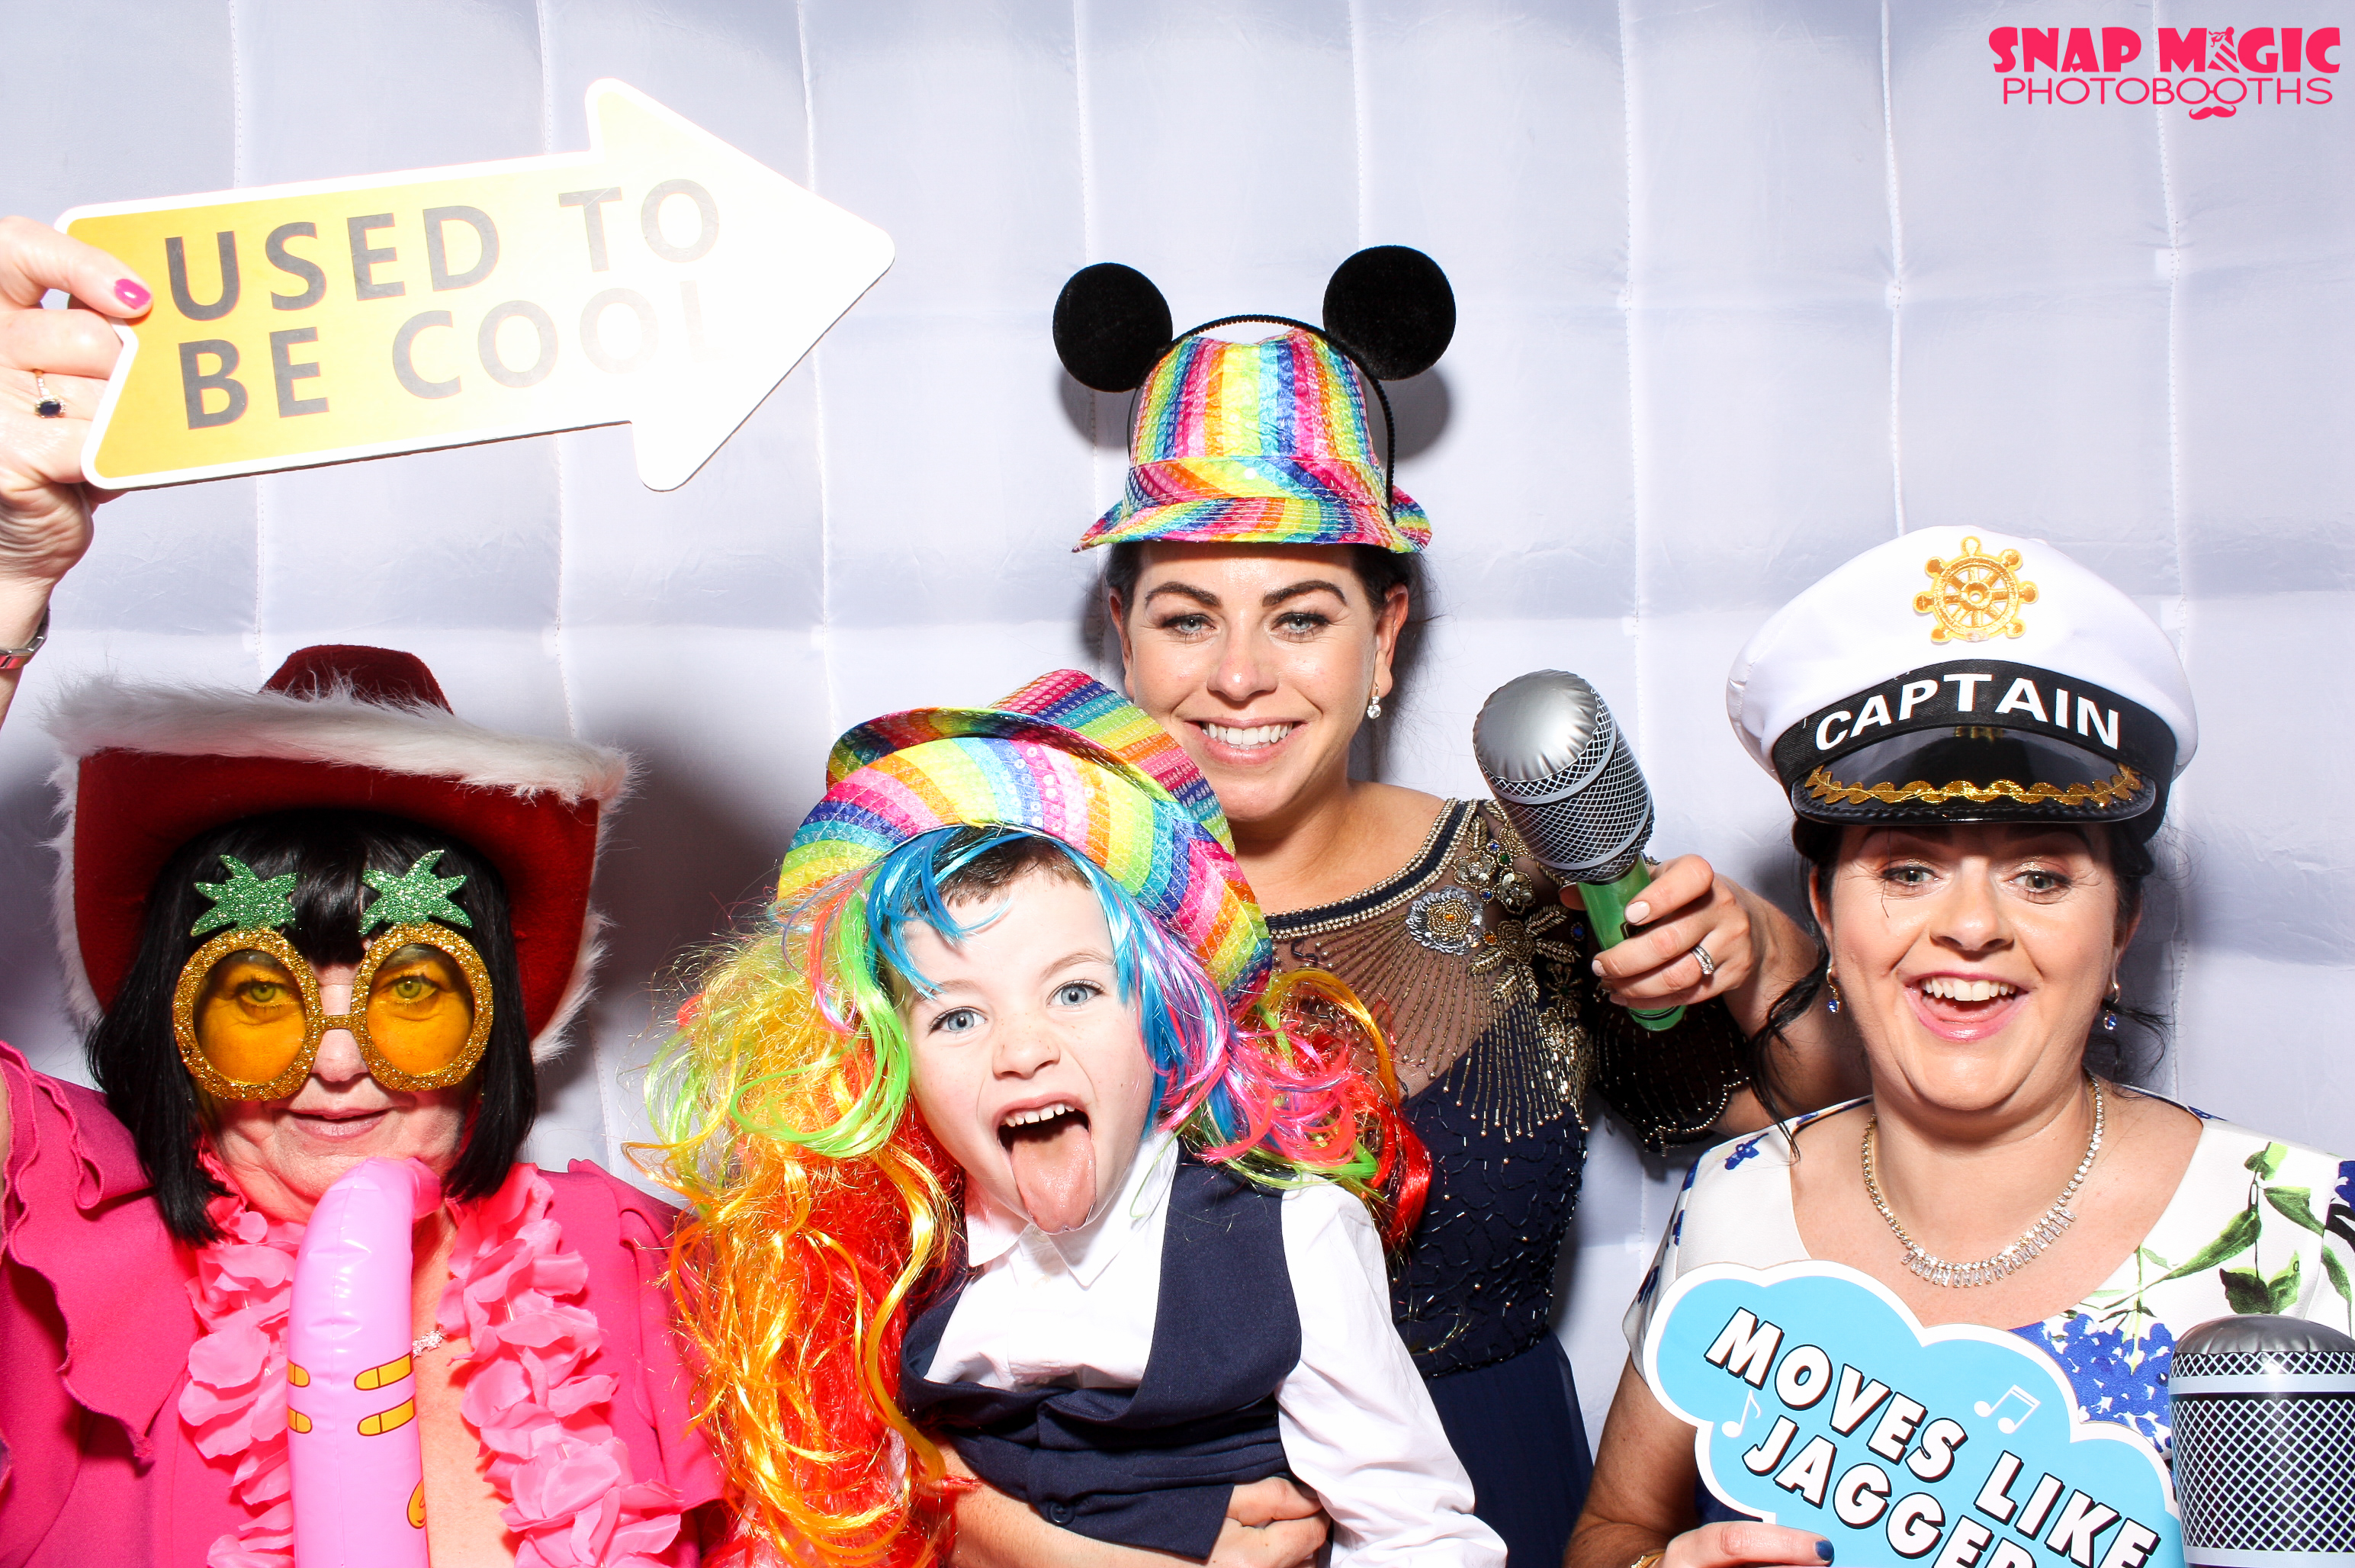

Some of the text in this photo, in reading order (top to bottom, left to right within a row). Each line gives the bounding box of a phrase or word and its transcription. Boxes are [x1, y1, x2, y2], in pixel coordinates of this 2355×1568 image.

[164, 178, 720, 322] USED TO
[178, 280, 734, 430] BE COOL
[1815, 673, 2119, 751] CAPTAIN
[1704, 1306, 2161, 1568] MOVES LIKE
